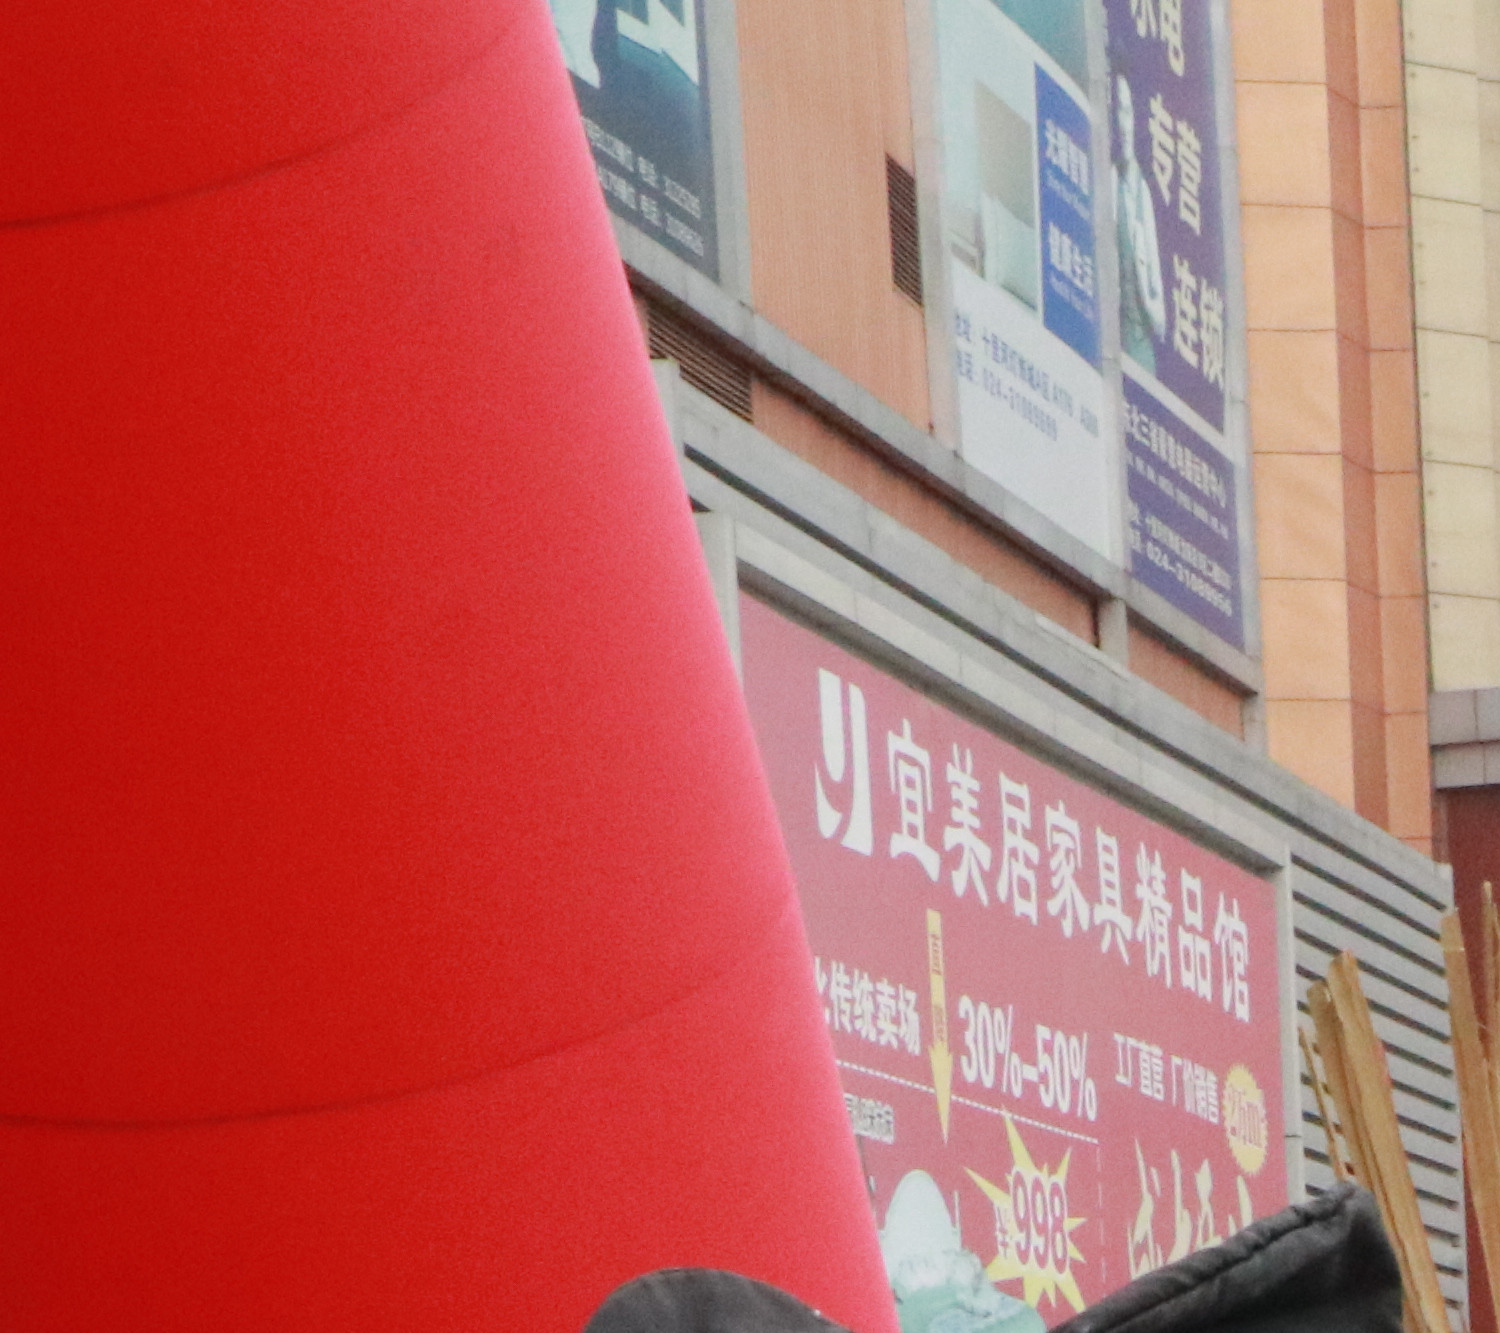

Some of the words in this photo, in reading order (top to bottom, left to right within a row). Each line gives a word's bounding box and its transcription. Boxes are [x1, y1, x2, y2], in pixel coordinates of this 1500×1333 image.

[886, 717, 1250, 1024] 宜美居家具精品馆
[957, 994, 1099, 1122] 30%-50%
